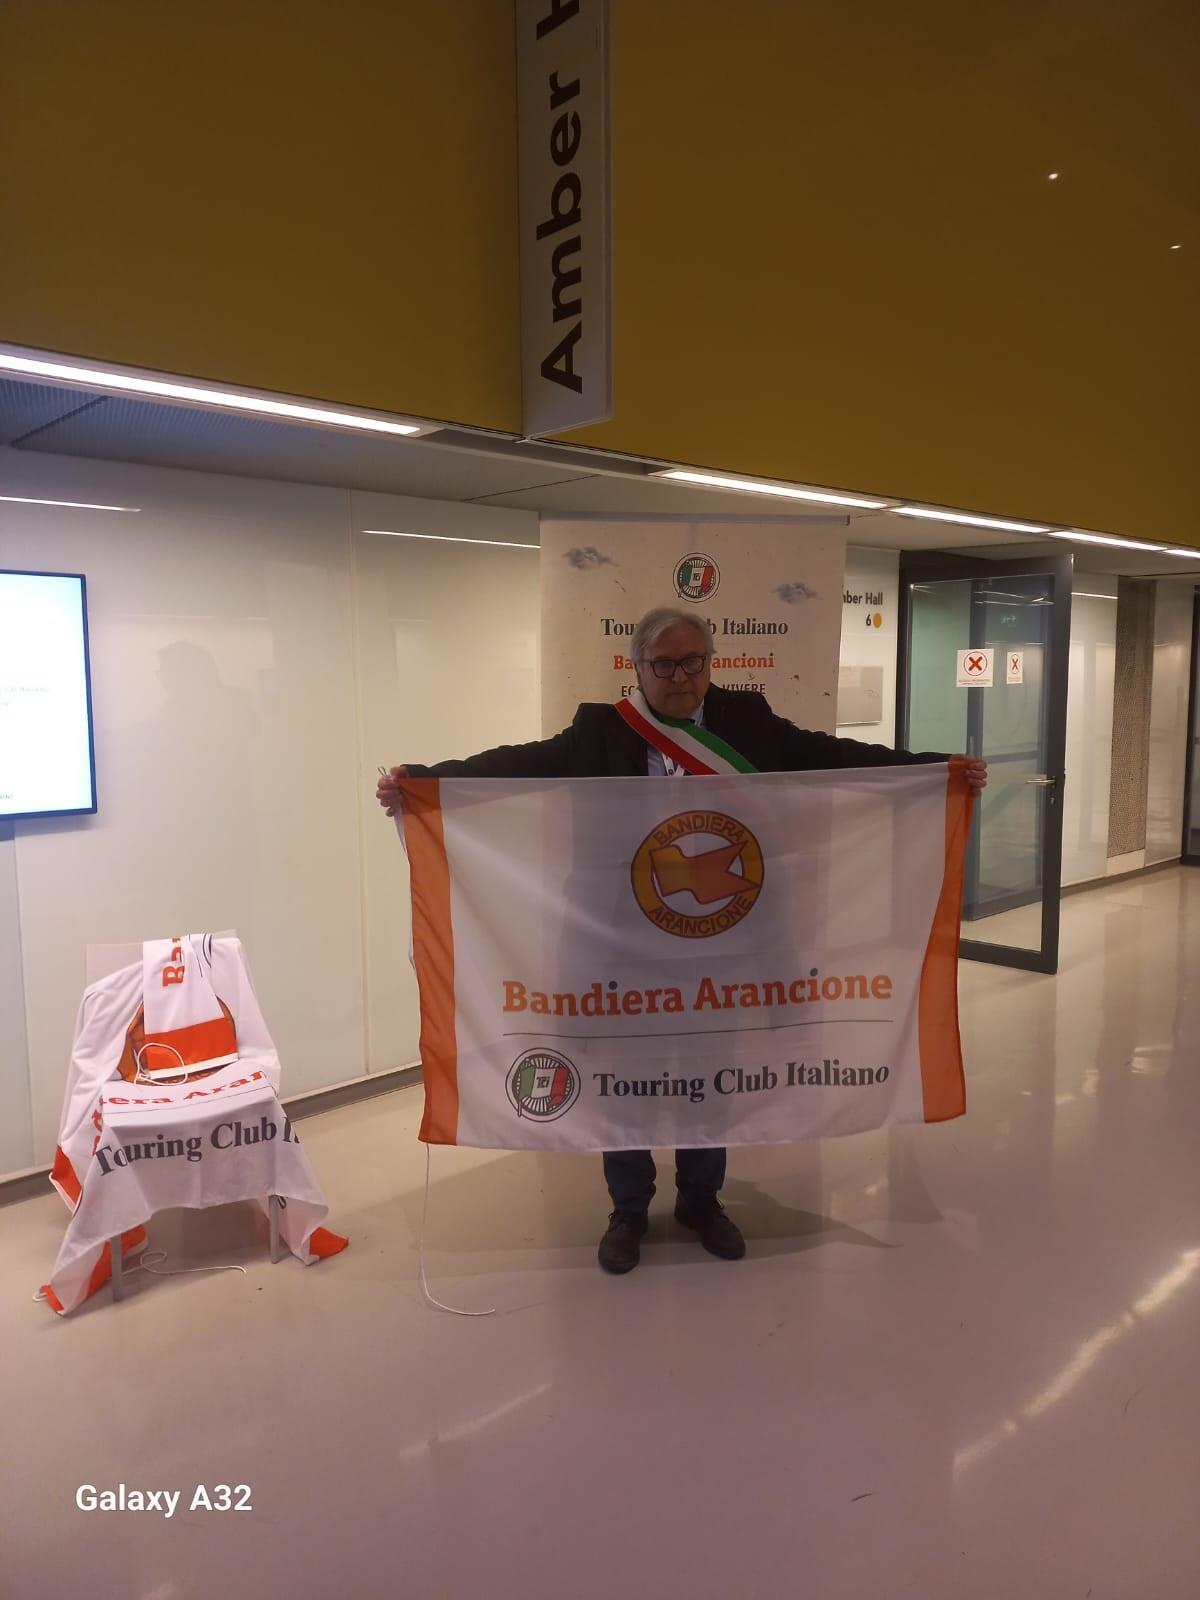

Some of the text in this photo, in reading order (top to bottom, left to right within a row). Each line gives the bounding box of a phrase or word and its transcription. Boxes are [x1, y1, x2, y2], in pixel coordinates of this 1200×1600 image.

[536, 71, 582, 394] Amber
[865, 592, 883, 605] Hall
[722, 618, 788, 635] Italiano
[866, 614, 872, 626] 6
[712, 652, 774, 669] ancioni
[653, 815, 747, 845] BANDIERA
[648, 896, 751, 934] ARANCIONE
[503, 968, 893, 1016] Bandiera Arancione
[593, 1059, 889, 1103] Touring Club Italiano
[96, 1134, 203, 1177] Touring
[211, 1117, 277, 1150] Club
